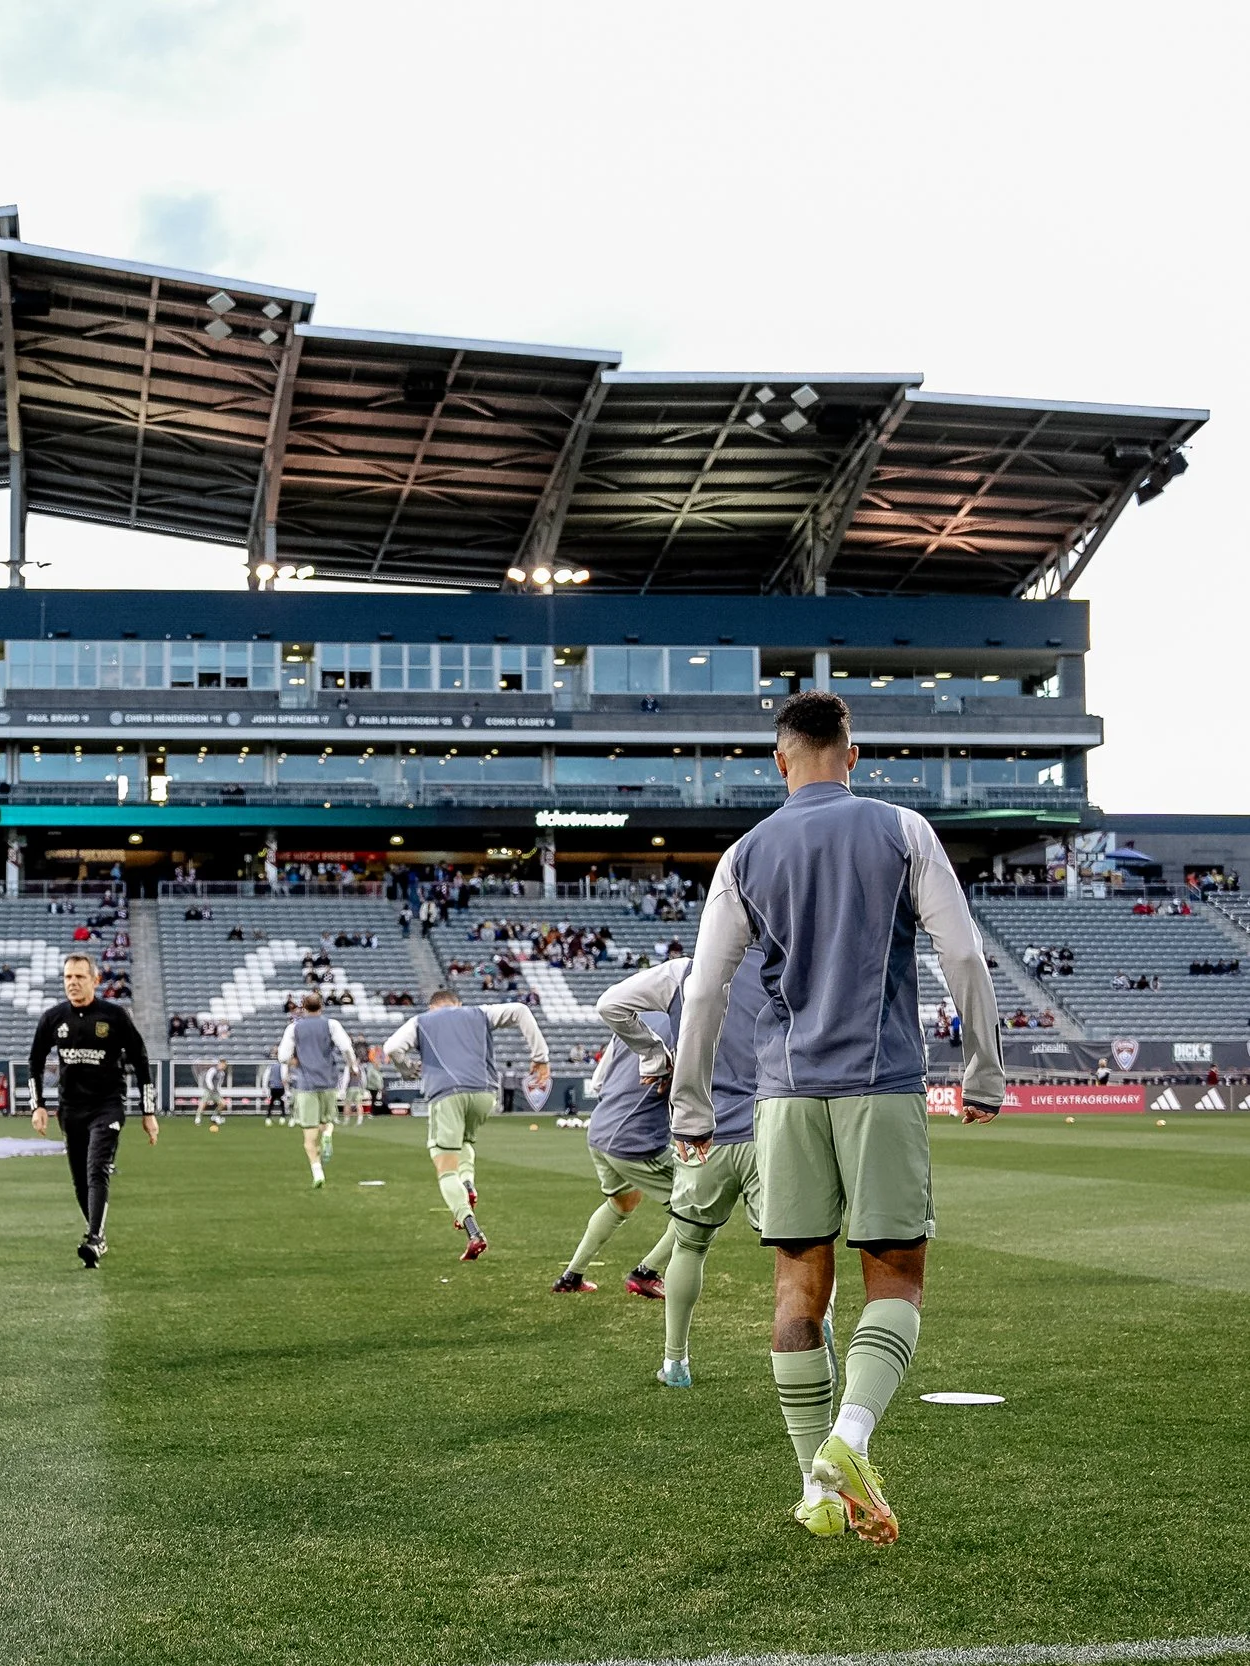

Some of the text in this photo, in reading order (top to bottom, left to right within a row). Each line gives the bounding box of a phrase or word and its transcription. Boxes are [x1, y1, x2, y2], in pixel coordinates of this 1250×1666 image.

[26, 713, 49, 722] PAUL
[50, 713, 80, 722] BRAVO
[124, 713, 152, 723] CHRIS
[153, 713, 209, 723] HENDERSON
[251, 715, 277, 723] JOHN
[277, 715, 320, 724] SPENCER
[358, 716, 388, 725] PABLO
[485, 717, 517, 726] CONOR
[517, 717, 546, 727] CASEY
[1031, 1095, 1054, 1105] LIVE
[1055, 1094, 1141, 1105] EXTRAORDINARY
